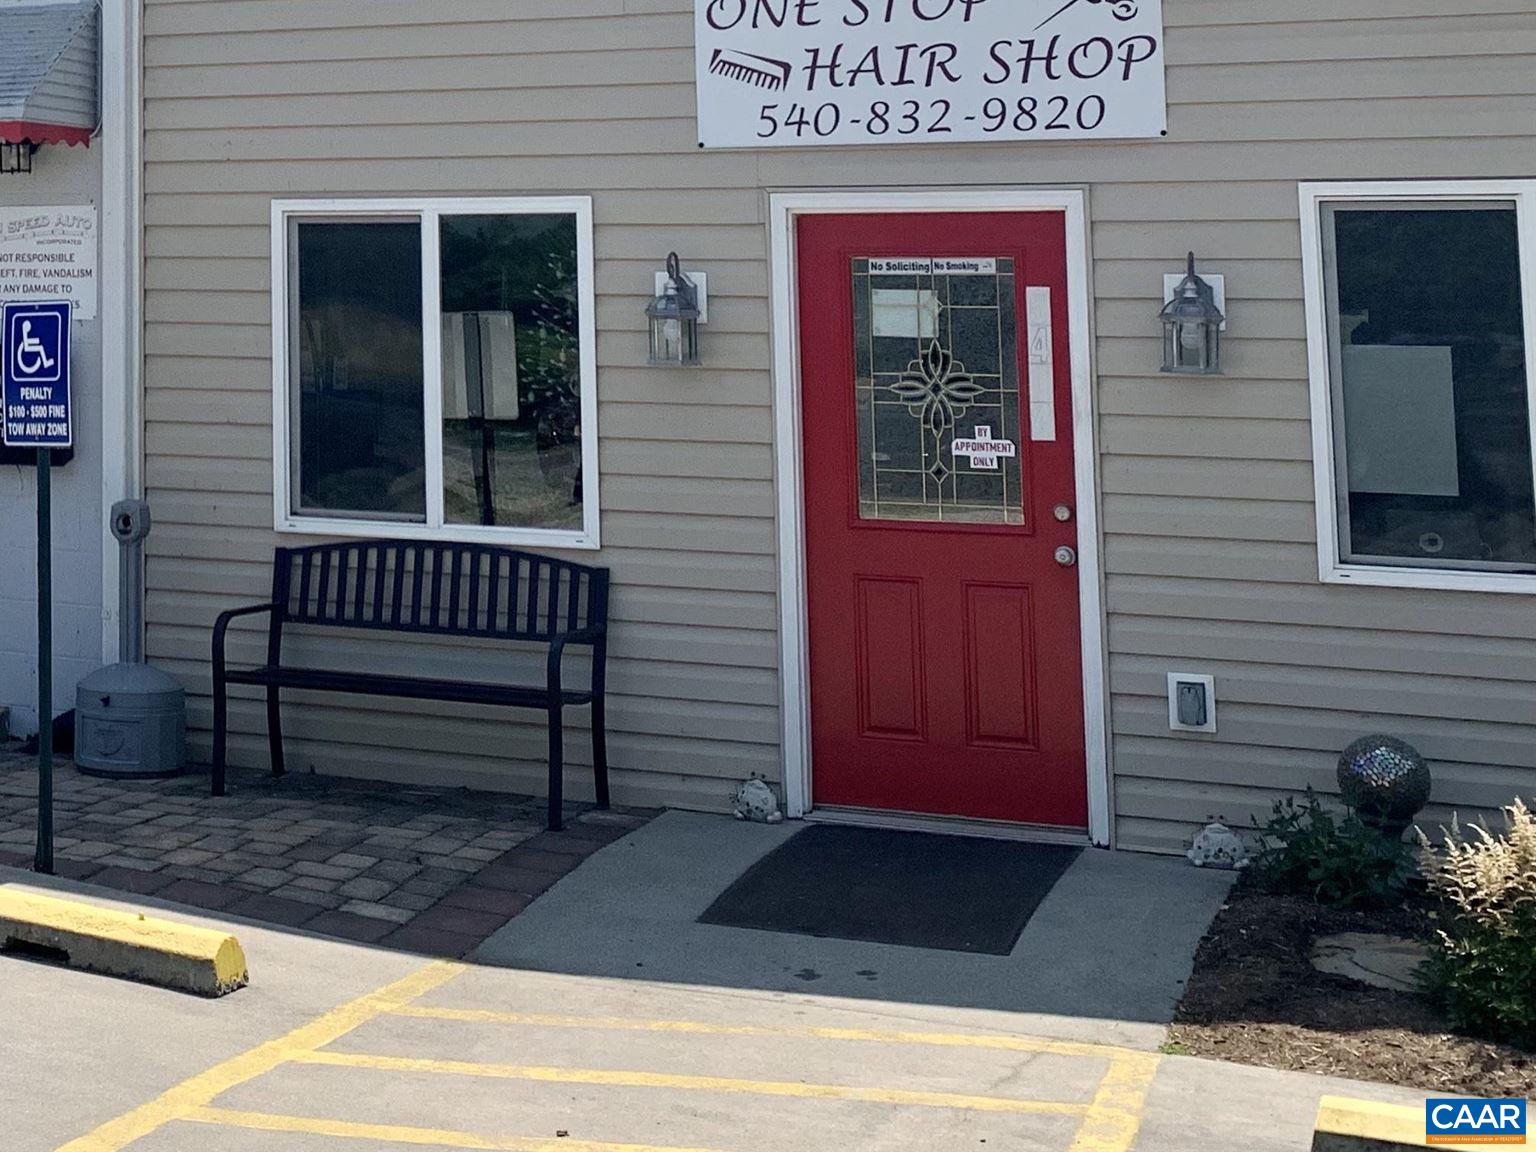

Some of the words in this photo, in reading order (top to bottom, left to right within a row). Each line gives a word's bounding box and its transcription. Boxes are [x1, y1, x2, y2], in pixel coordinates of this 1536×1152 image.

[802, 43, 962, 92] HAIR
[982, 34, 1158, 84] SHOP
[756, 95, 1106, 138] 540-832-9820
[8, 215, 50, 234] SPEED
[55, 214, 92, 230] AUTO
[15, 253, 75, 263] RESPONSIBLE
[871, 262, 883, 271] No
[885, 261, 930, 273] Soliciting
[934, 262, 944, 270] No
[946, 261, 979, 271] Smoking
[43, 269, 92, 278] VANDALISM
[4, 284, 20, 293] ANY
[22, 284, 59, 293] DAMAGE
[61, 284, 72, 293] TO
[20, 387, 52, 400] PENALTY
[9, 405, 25, 418] $100
[30, 405, 47, 418] $500
[48, 405, 65, 418] FINE
[8, 423, 25, 436] TOW
[26, 423, 46, 436] AWAY
[47, 423, 67, 436] ZONE
[977, 428, 987, 437] BY
[955, 441, 1012, 453] APPOINTMENT
[973, 456, 994, 467] ONLY
